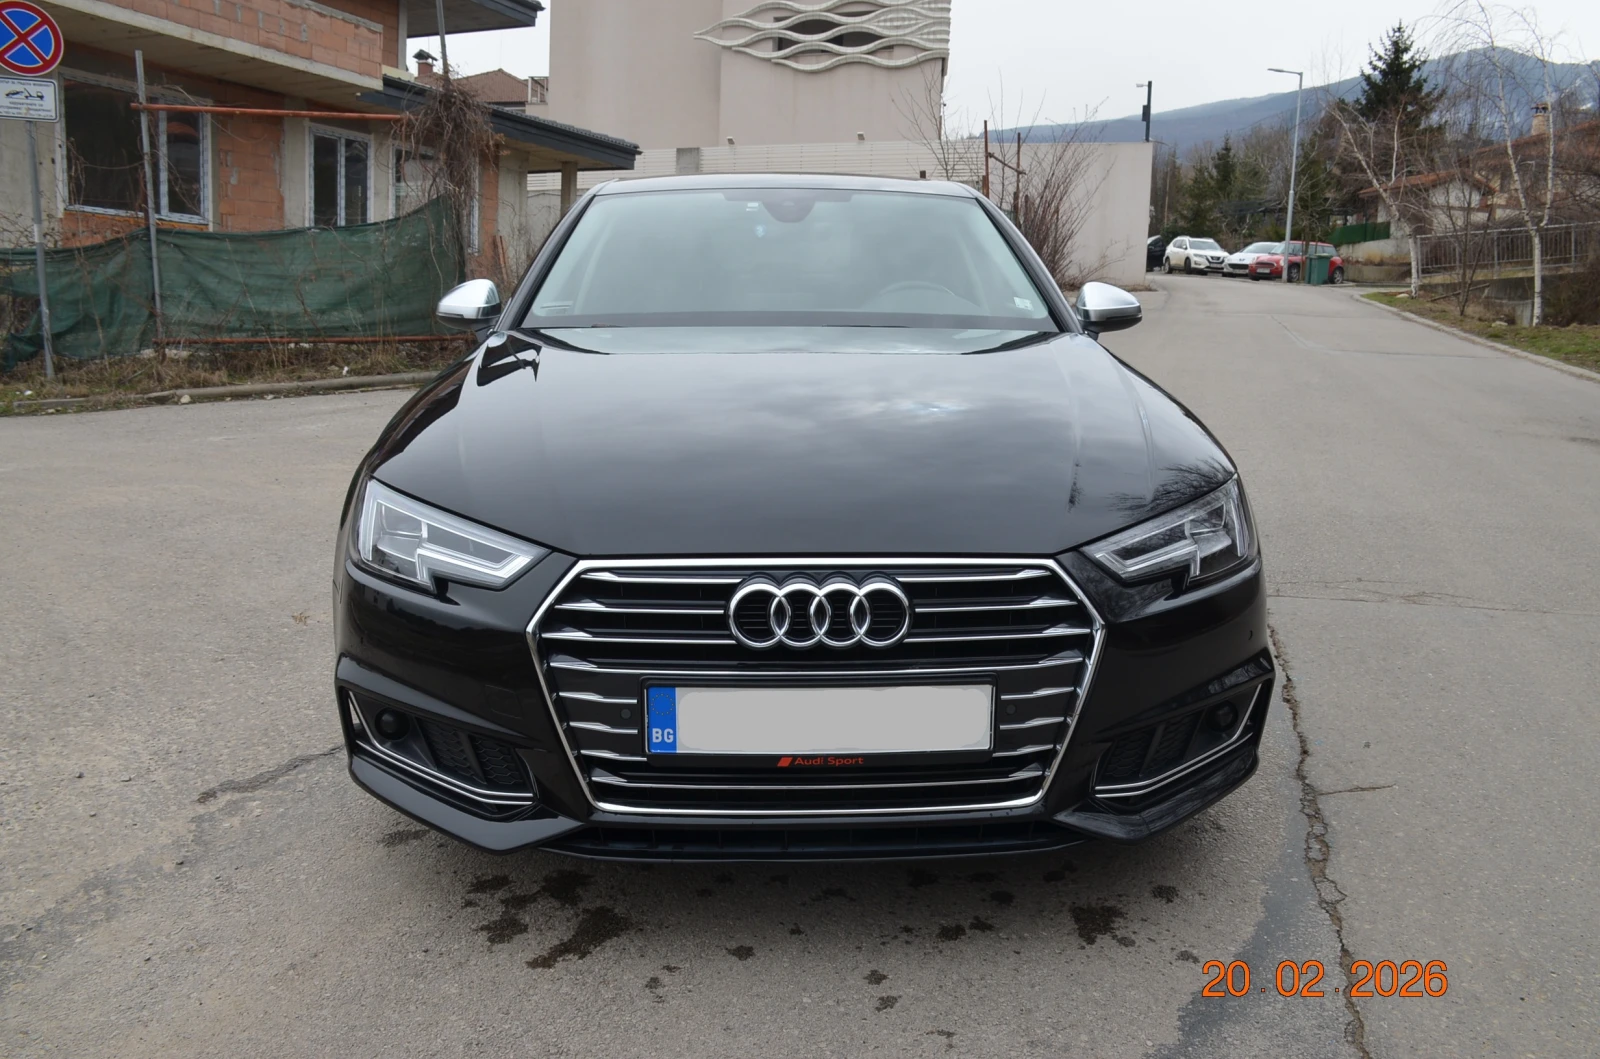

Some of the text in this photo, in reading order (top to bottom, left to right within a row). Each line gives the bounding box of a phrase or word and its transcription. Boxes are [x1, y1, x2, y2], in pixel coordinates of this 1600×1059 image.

[652, 728, 674, 743] BG
[794, 757, 864, 767] Audi Sport
